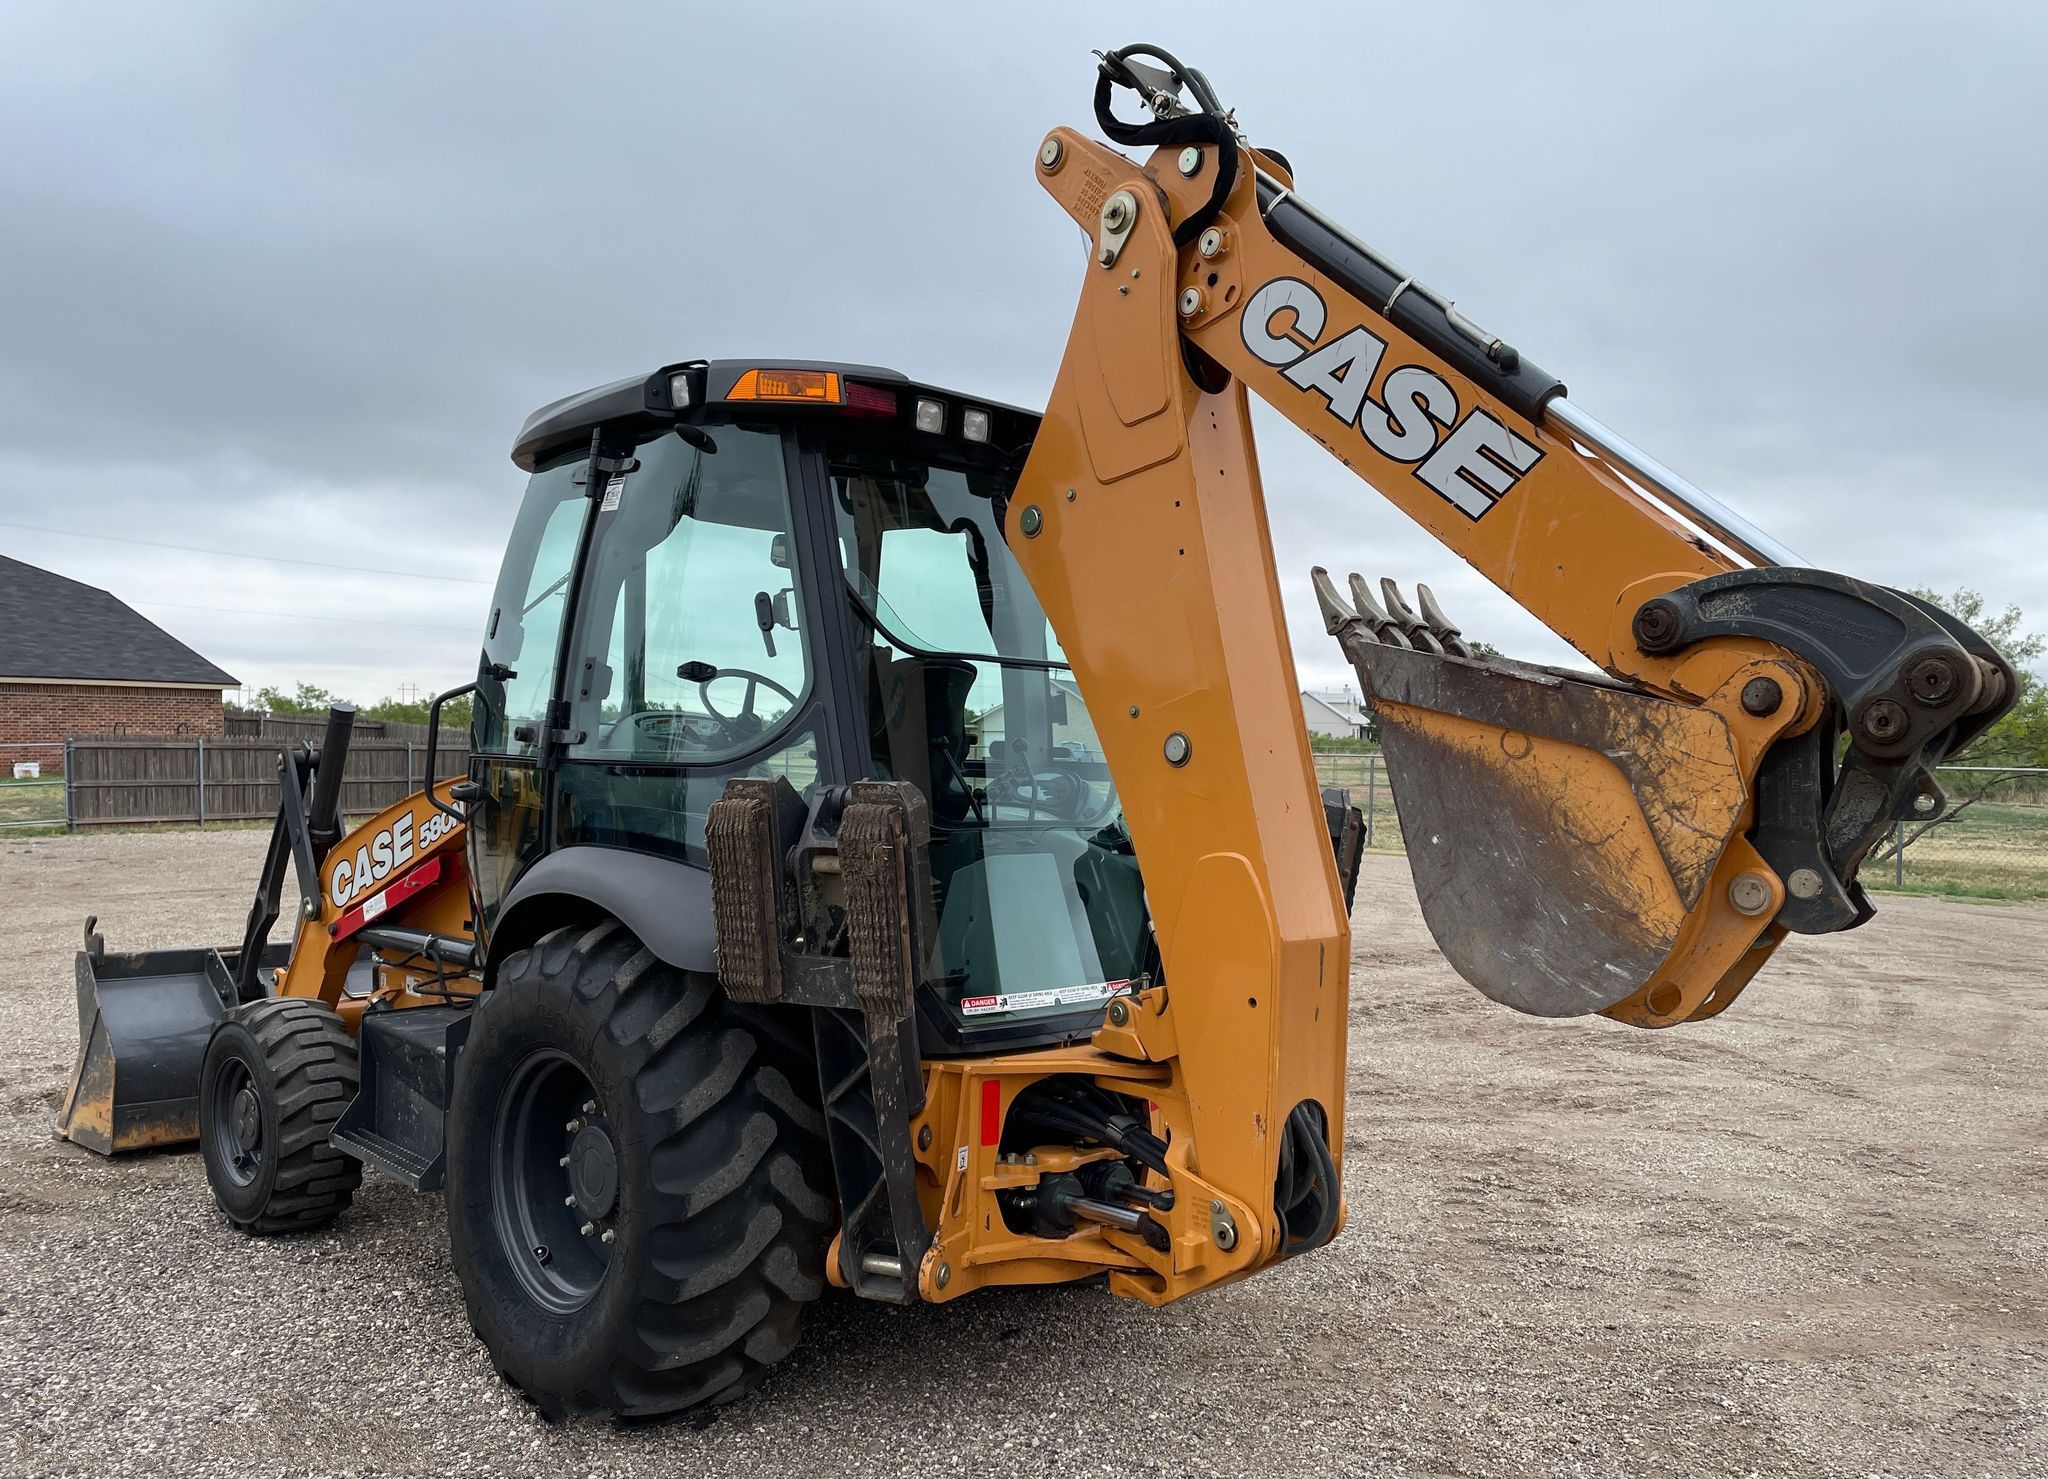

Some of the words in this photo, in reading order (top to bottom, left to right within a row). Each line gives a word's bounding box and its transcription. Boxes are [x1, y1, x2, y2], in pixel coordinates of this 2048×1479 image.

[1240, 276, 1547, 522] CASE
[331, 810, 413, 908] CASE
[971, 998, 996, 1007] DANGER
